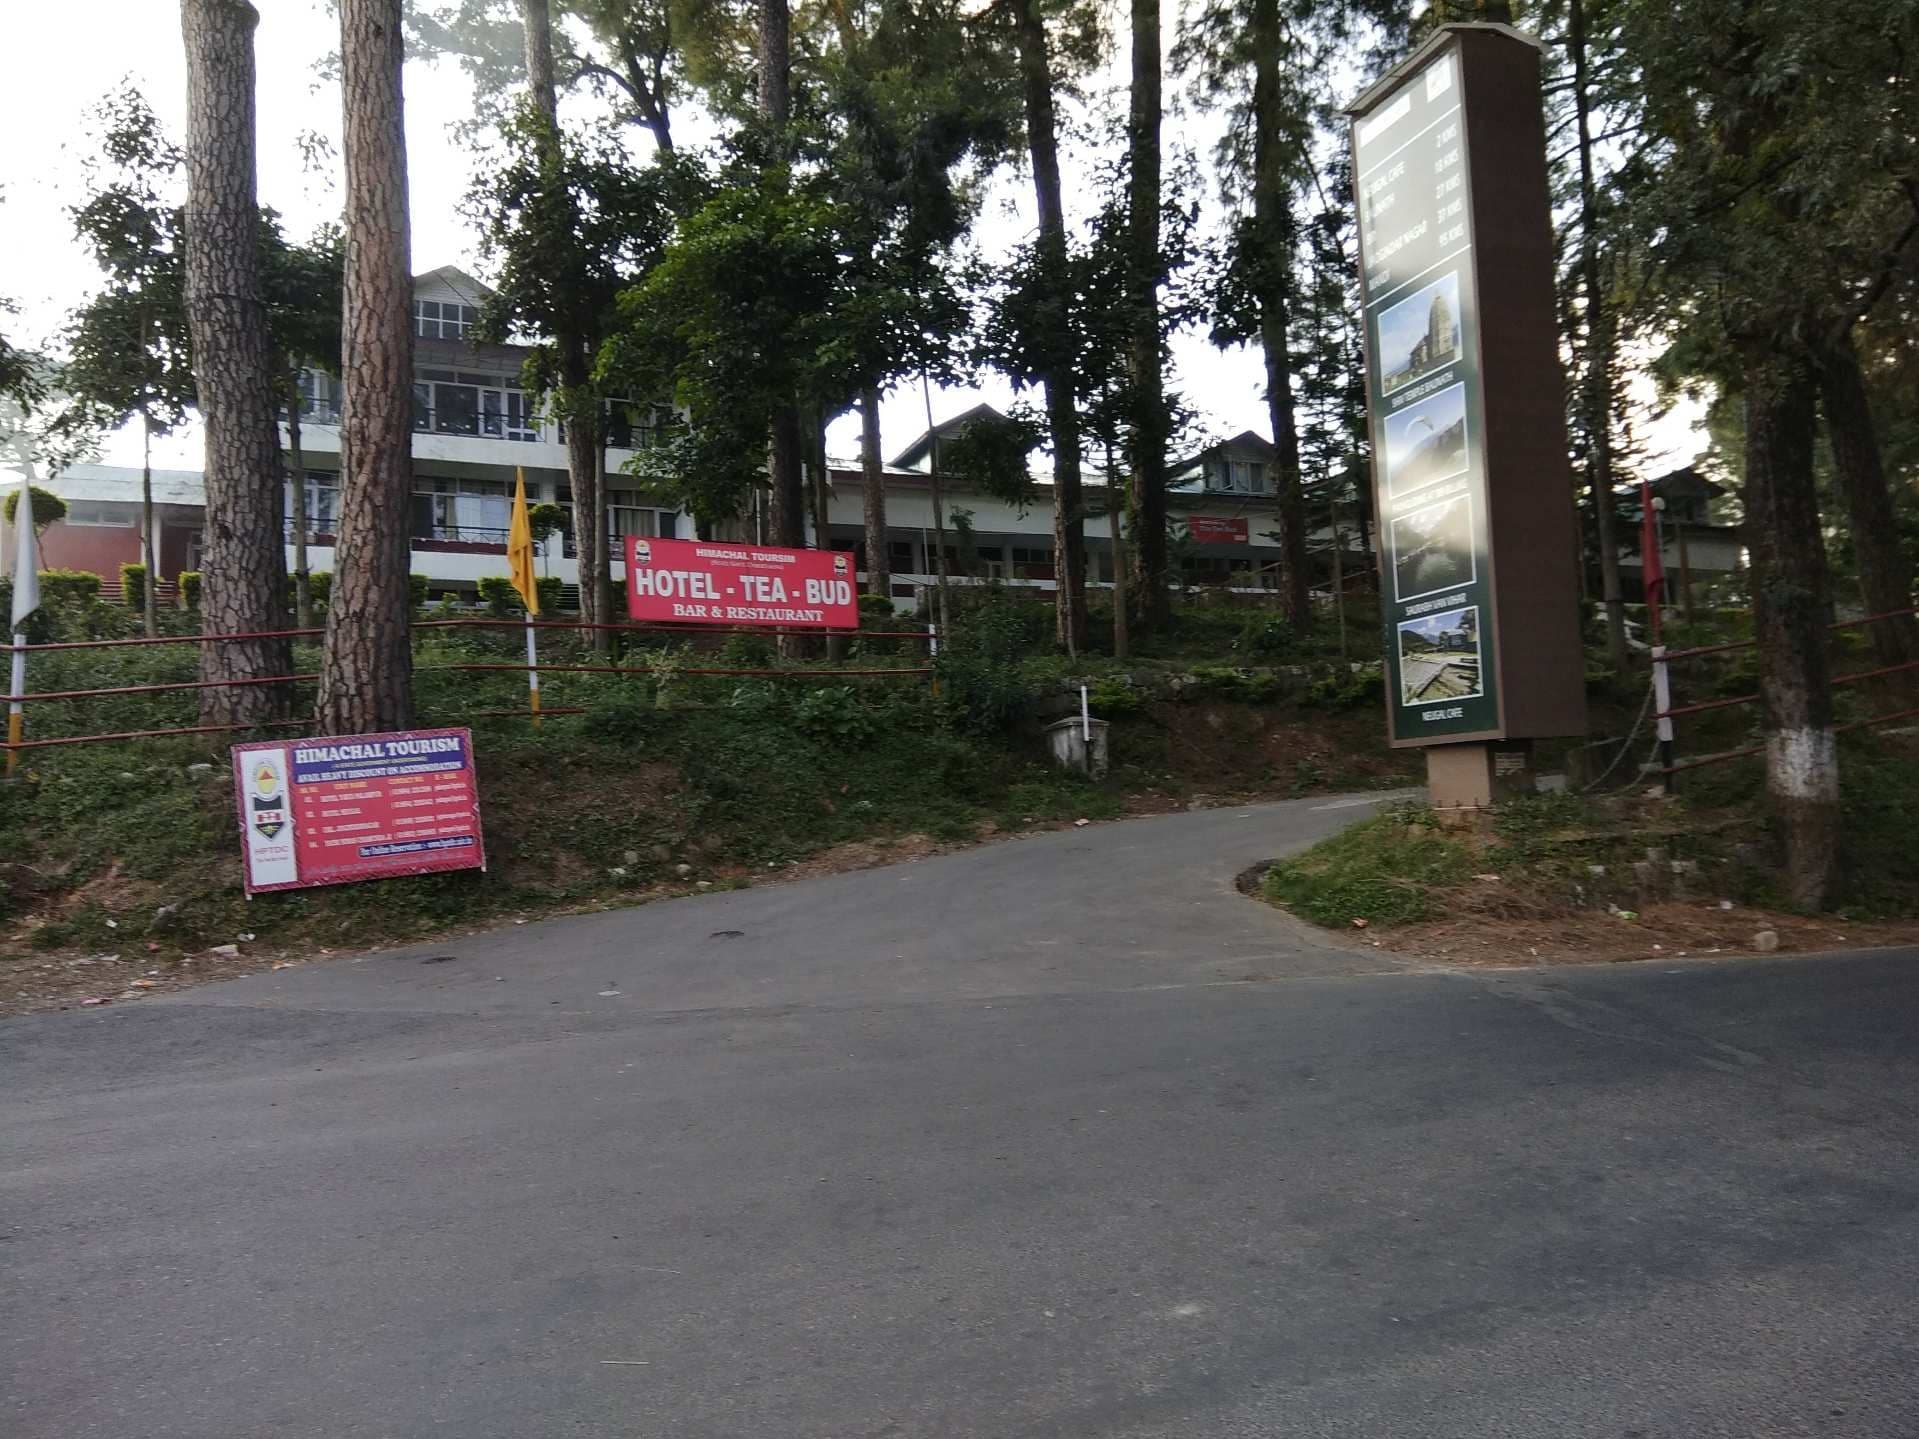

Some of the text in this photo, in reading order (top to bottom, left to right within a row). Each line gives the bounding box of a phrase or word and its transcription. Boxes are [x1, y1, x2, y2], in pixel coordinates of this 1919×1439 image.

[696, 547, 749, 562] HIMACHAL
[634, 567, 721, 600] HOTEL
[740, 575, 788, 603] TEA
[805, 578, 851, 606] BUD
[673, 603, 824, 622] BAR & RESTAURANT
[295, 743, 386, 764] HIMACHAL
[386, 737, 460, 756] TOURISM
